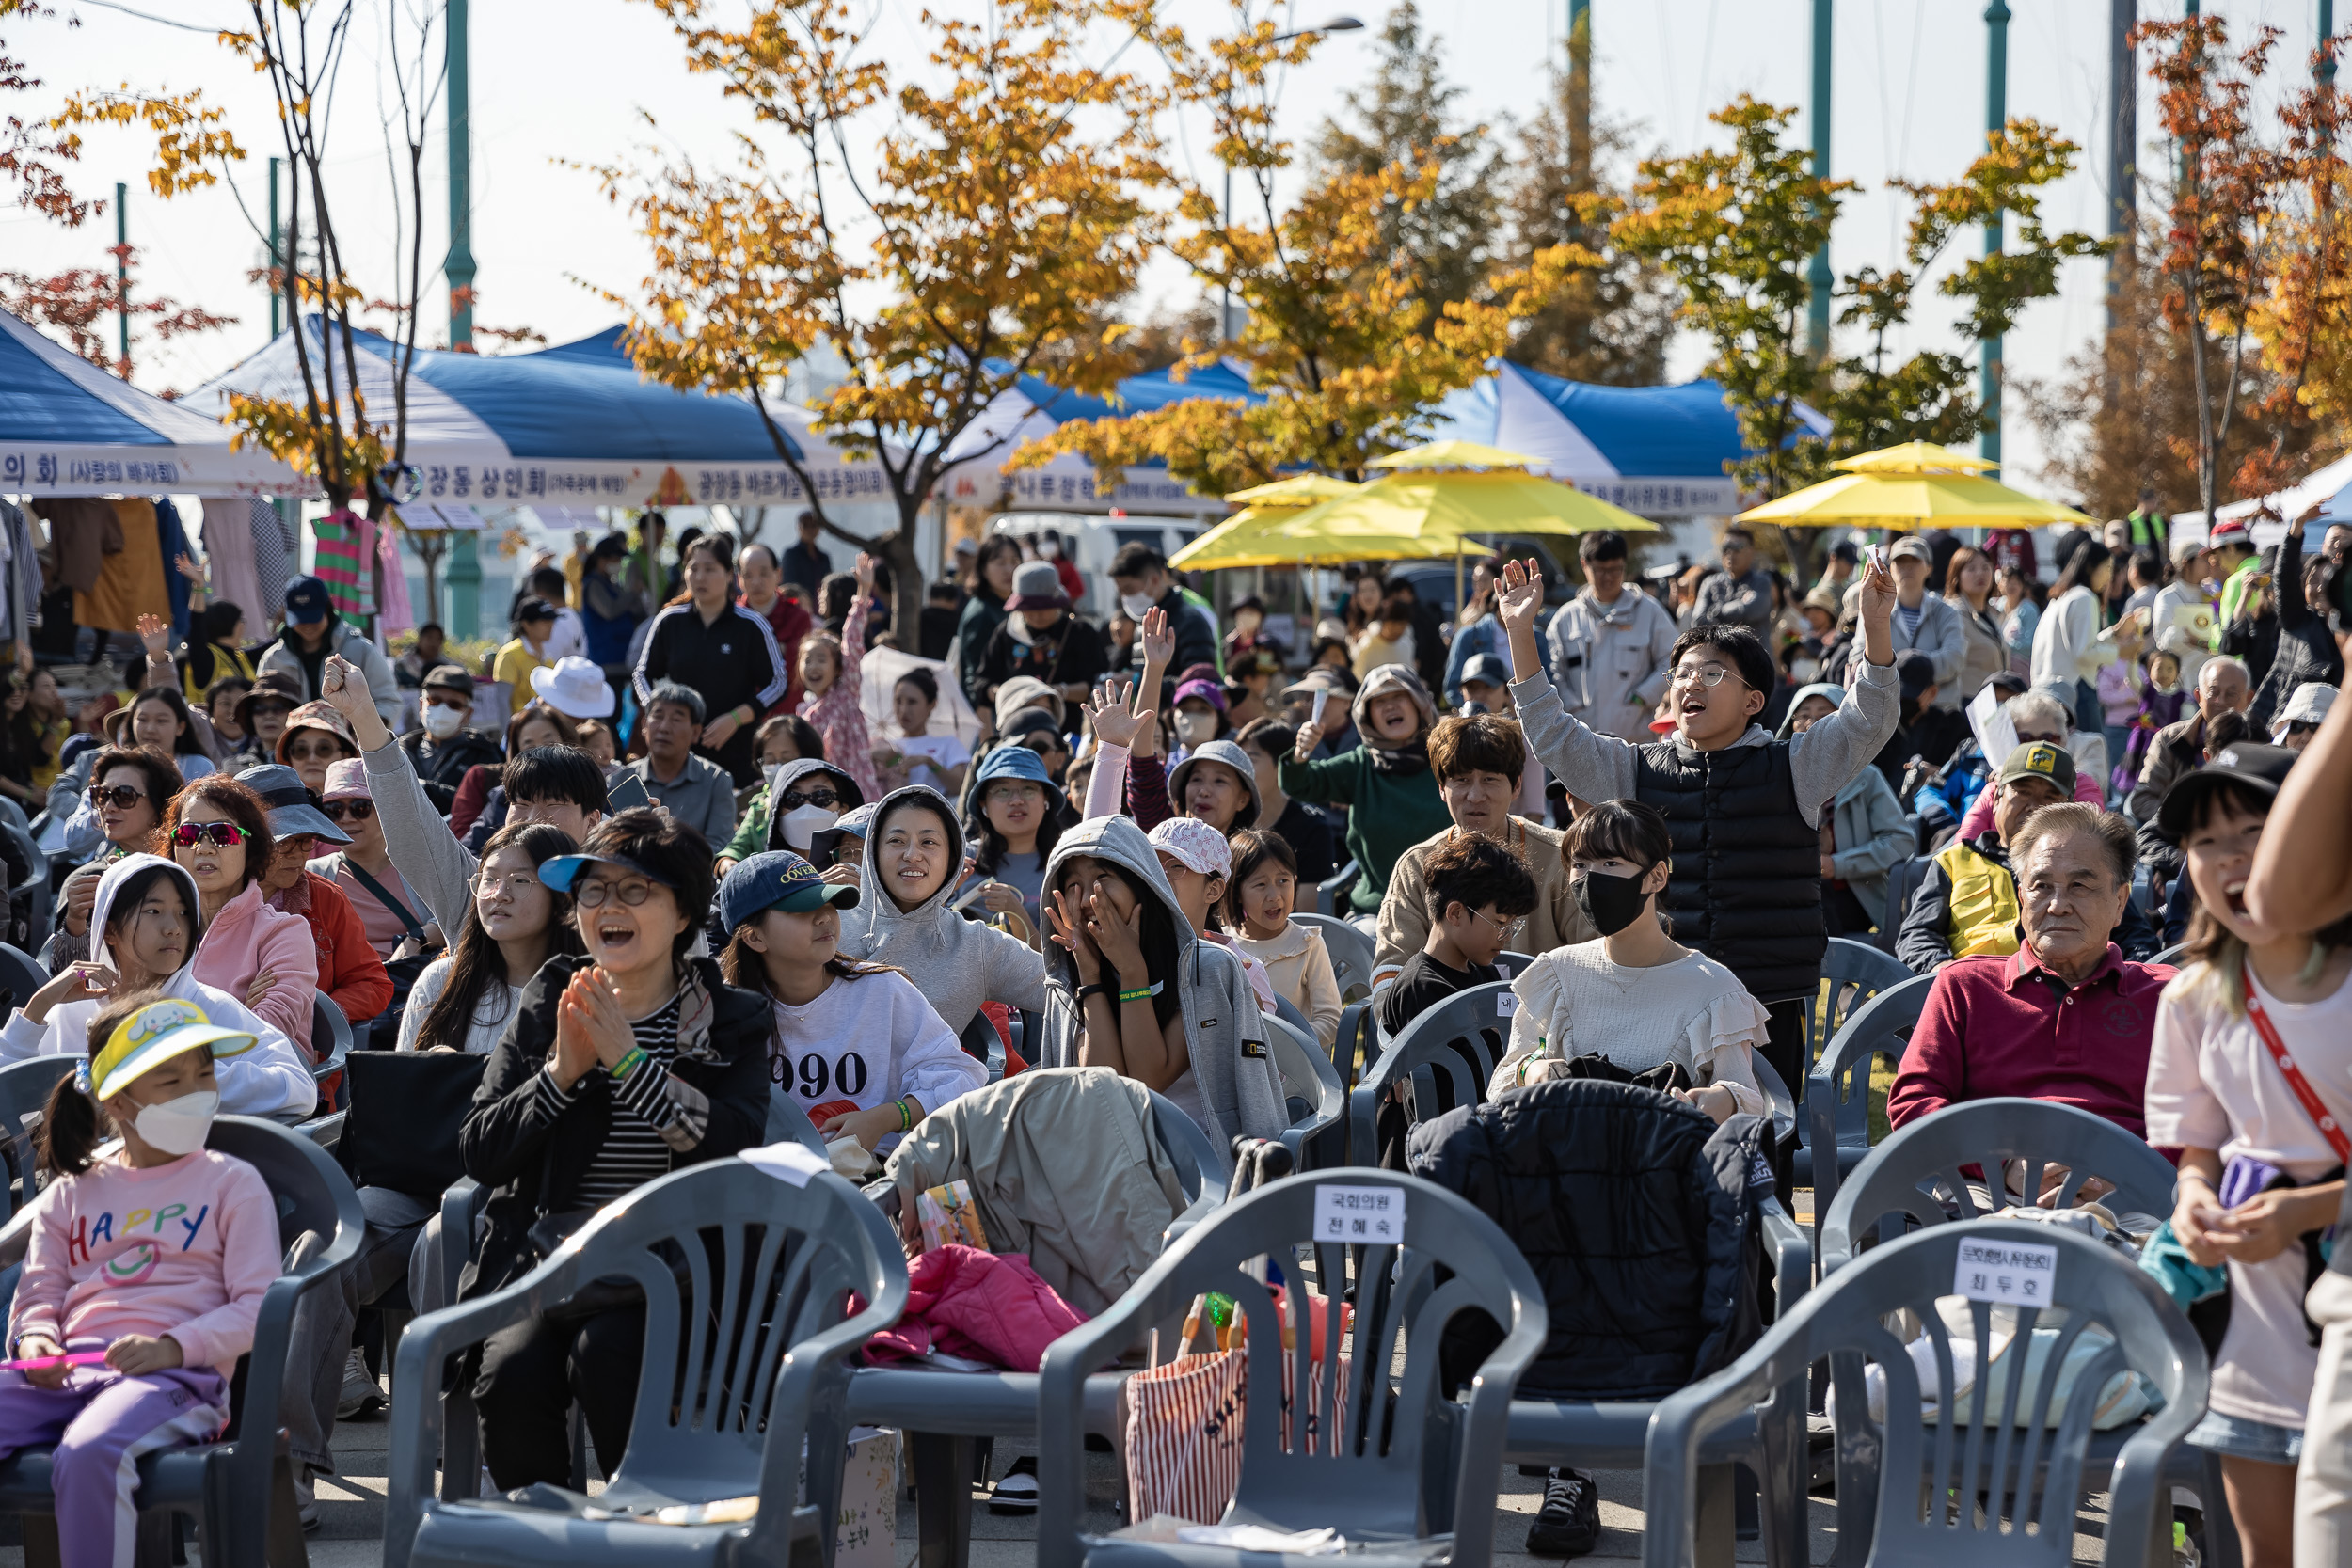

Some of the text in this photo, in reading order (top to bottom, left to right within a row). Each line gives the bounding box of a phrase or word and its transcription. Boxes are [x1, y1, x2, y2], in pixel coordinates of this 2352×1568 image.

[1331, 1193, 1390, 1211] 국회의원
[69, 1203, 209, 1266] HAPPY
[1962, 1245, 2051, 1271] 문화행사위원회
[847, 1525, 869, 1550] 농협
